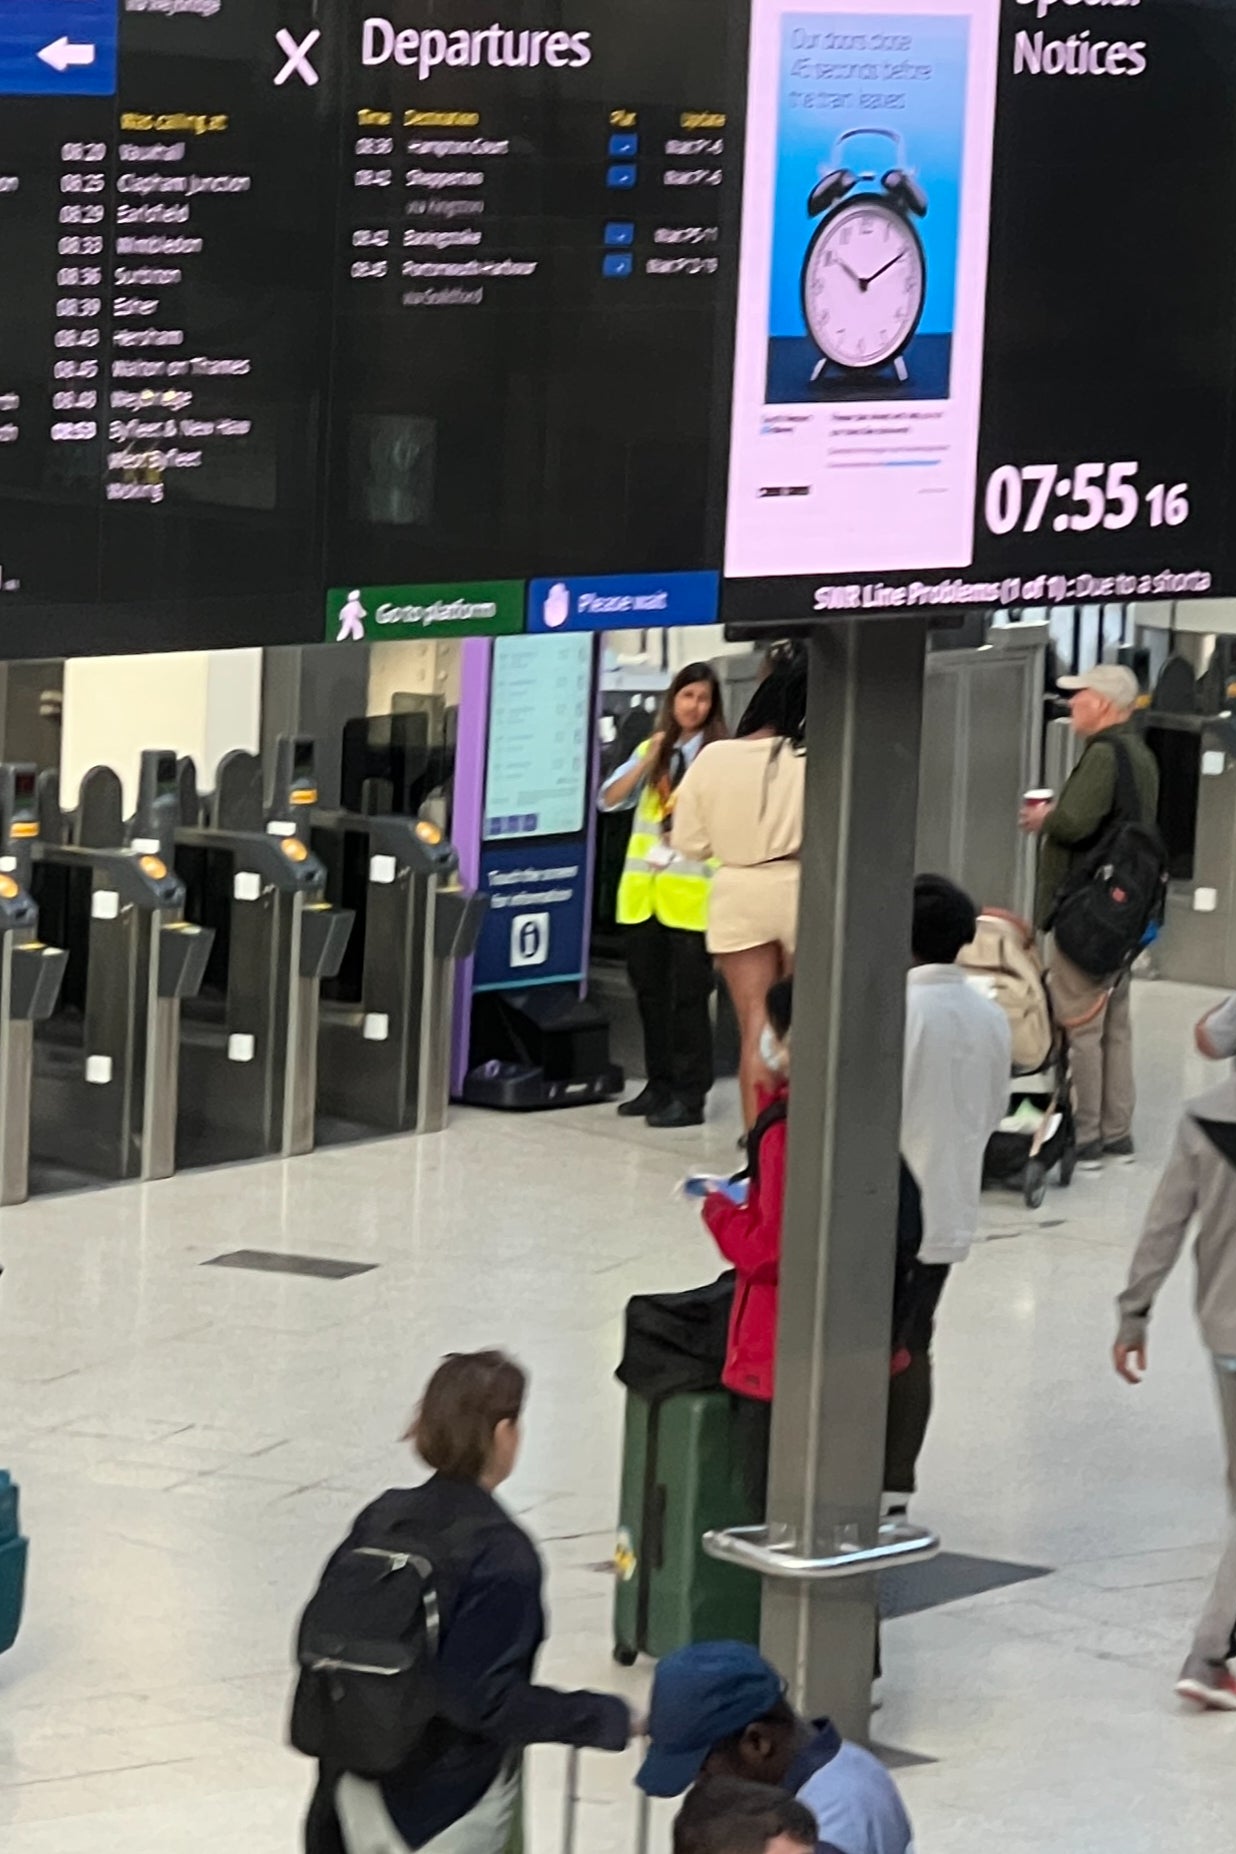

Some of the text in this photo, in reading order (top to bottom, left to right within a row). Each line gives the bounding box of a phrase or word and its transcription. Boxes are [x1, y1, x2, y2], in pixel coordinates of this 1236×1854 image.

[362, 17, 592, 81] Departures
[1013, 30, 1147, 76] Notices
[985, 461, 1189, 535] 07:55 16
[578, 592, 632, 613] Please
[861, 582, 907, 608] Line
[907, 578, 1000, 605] Problems
[1022, 574, 1047, 600] of
